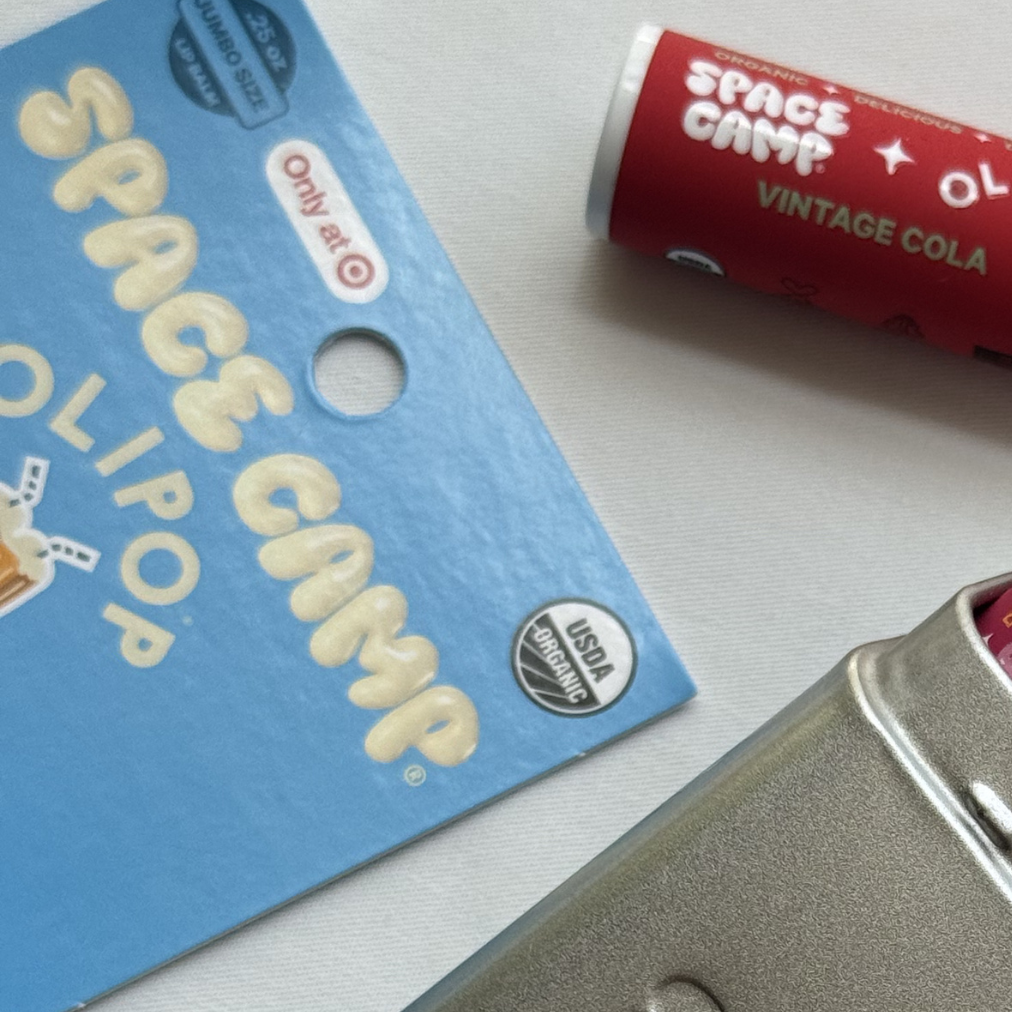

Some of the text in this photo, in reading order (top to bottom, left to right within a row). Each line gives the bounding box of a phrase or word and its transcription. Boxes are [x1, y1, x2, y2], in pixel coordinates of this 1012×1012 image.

[245, 13, 276, 43] .25
[235, 68, 270, 113] SIZE
[685, 58, 852, 136] SPACE
[714, 51, 808, 86] ORGANIC
[854, 94, 963, 134] DELICIOUS
[683, 101, 834, 176] CAMP
[282, 153, 352, 255] Only at
[757, 179, 988, 275] VINTAGE COLA
[18, 67, 480, 767] SPACE CAMP
[0, 343, 200, 668] OLIPOP
[534, 627, 587, 703] ORGANIC
[566, 618, 615, 684] USDA
